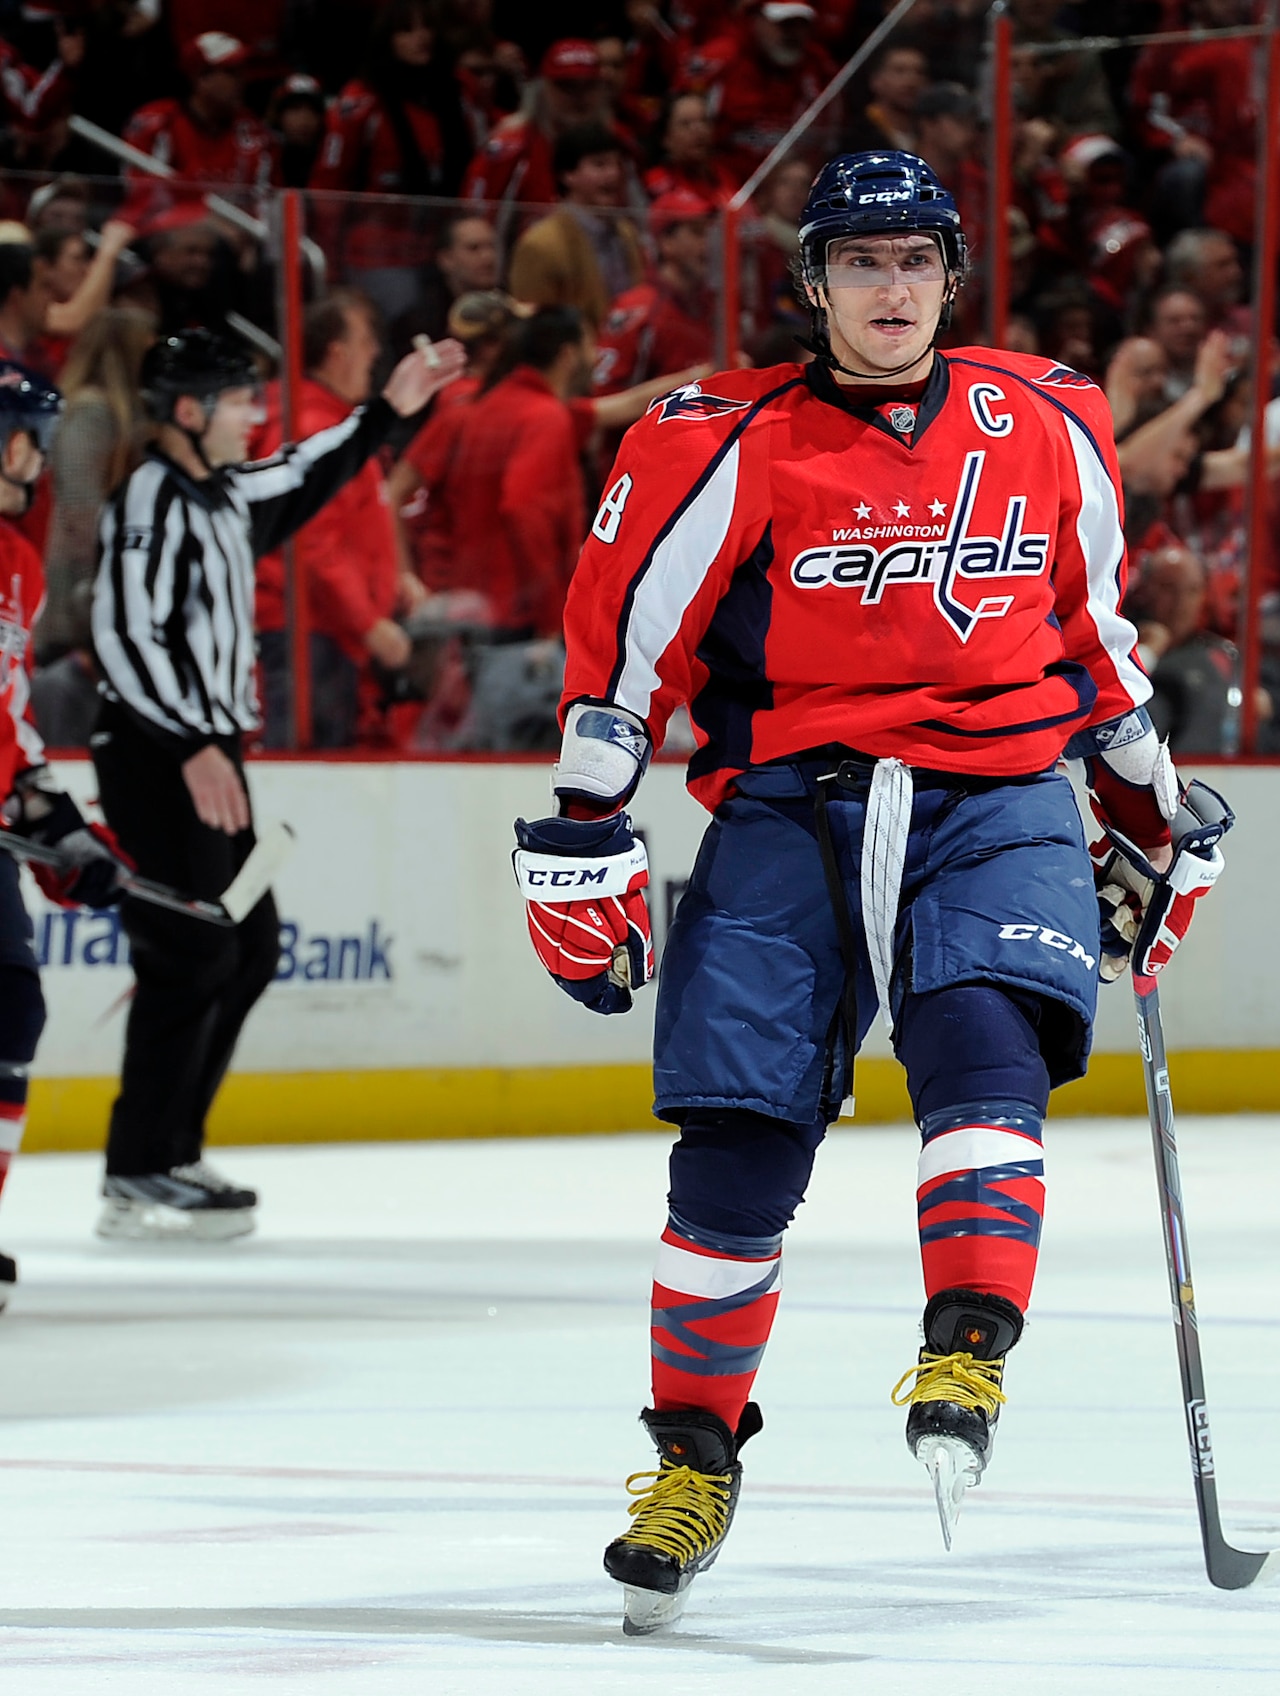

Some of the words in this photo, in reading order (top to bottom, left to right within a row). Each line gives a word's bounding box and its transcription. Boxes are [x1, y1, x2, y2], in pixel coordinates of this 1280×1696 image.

[858, 190, 910, 205] CCM
[968, 382, 1014, 438] C
[591, 472, 633, 544] 8
[832, 523, 946, 542] WASHINGTON
[789, 450, 1050, 645] capitals
[526, 866, 609, 887] CCM
[275, 920, 393, 981] Bank
[997, 923, 1095, 971] CCM
[1194, 1403, 1215, 1474] CCM
